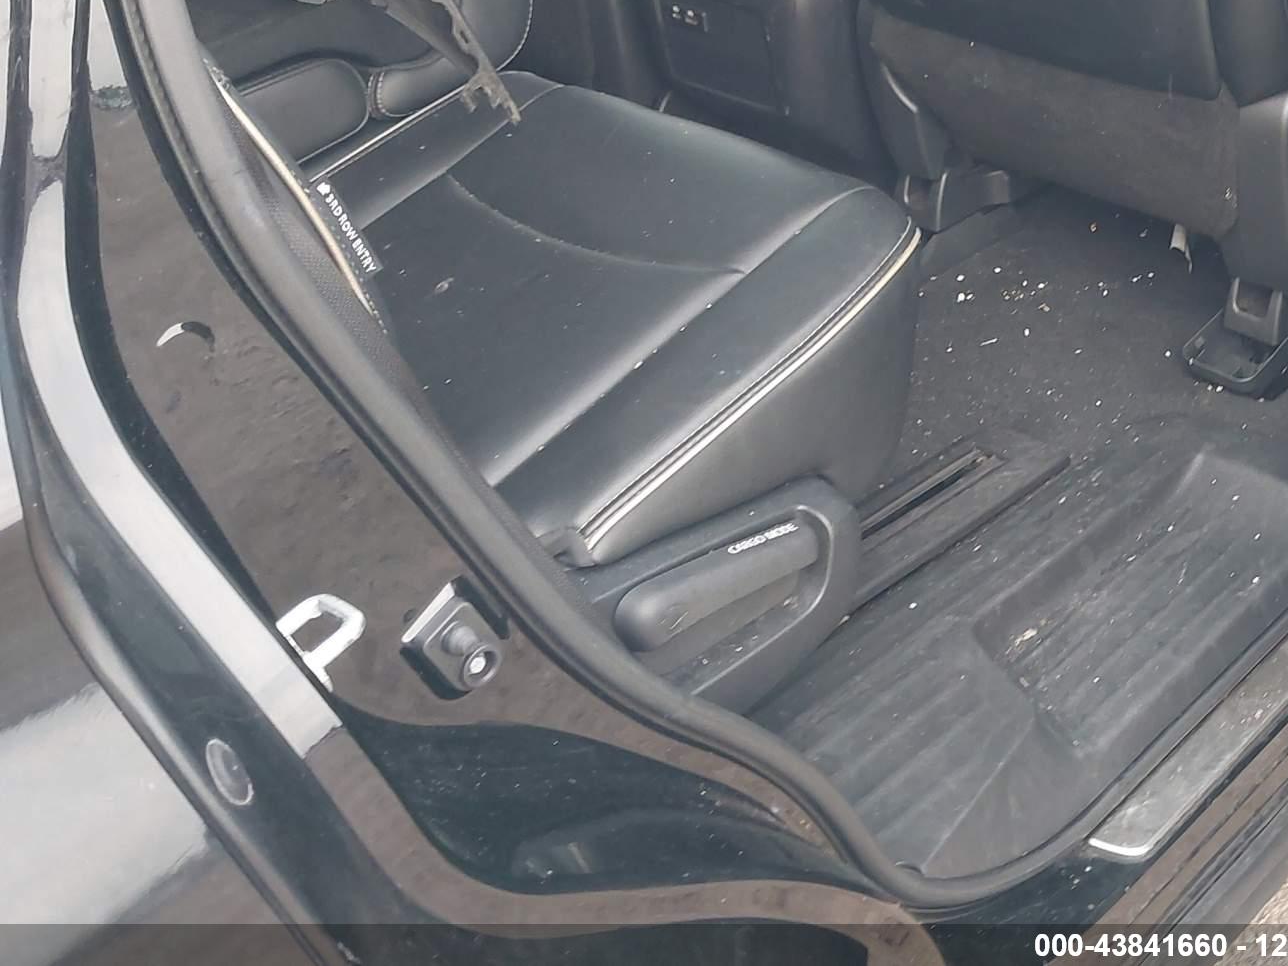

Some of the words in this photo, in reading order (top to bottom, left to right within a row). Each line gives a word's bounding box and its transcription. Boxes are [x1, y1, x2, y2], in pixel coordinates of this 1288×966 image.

[325, 194, 343, 217] 3RD
[338, 213, 358, 241] ROW
[352, 238, 377, 273] ENTRY
[727, 535, 767, 554] CARGO
[763, 522, 799, 540] MODE
